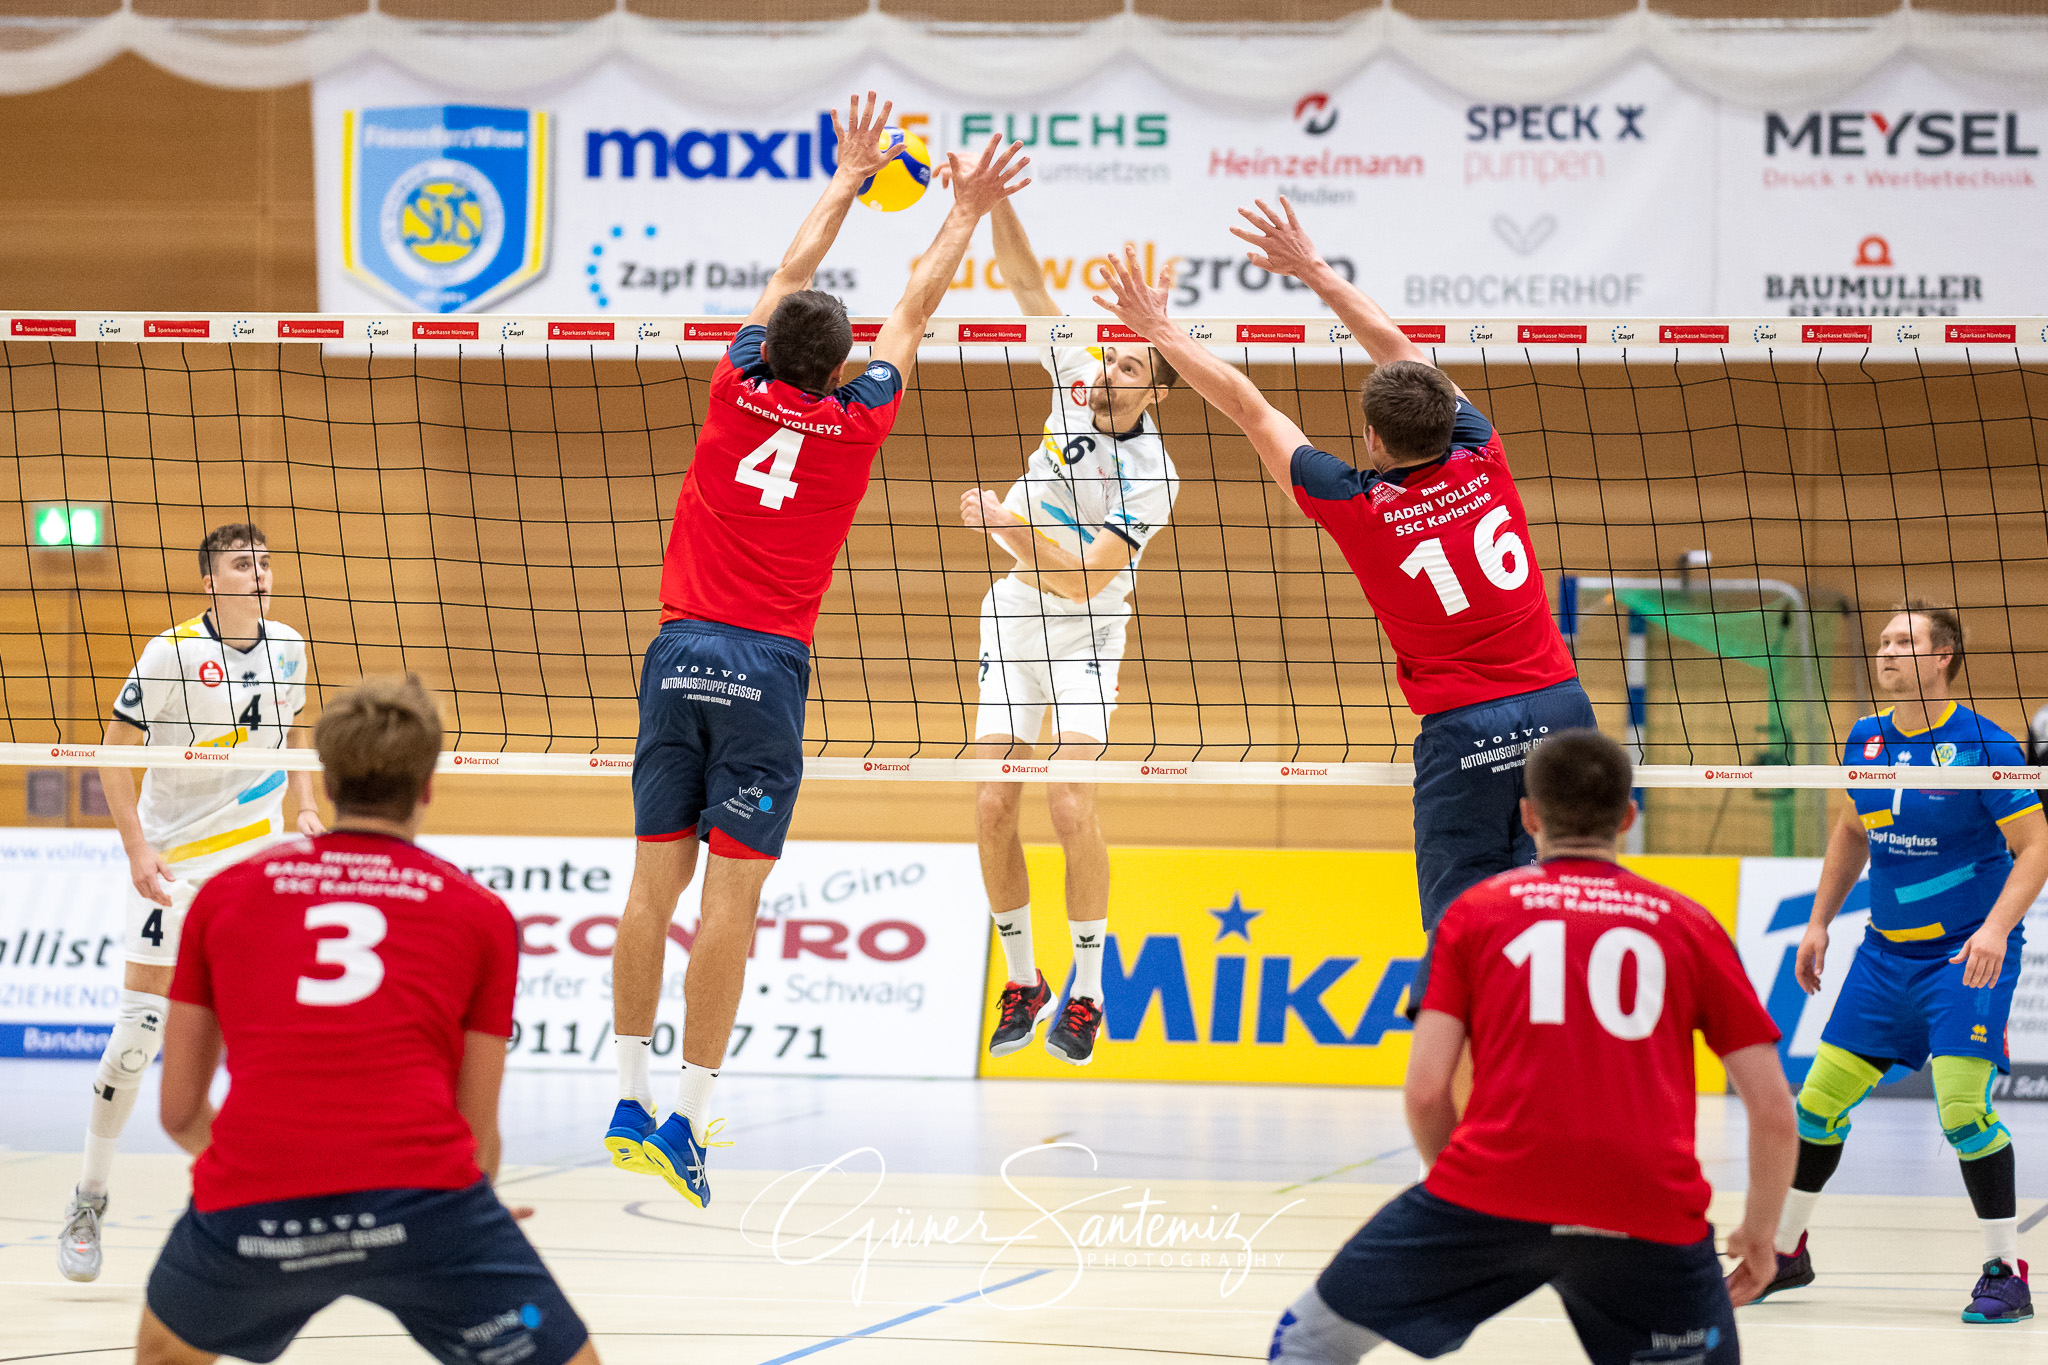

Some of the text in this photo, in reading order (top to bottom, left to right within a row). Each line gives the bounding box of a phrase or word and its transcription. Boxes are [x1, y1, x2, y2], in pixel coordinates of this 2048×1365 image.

[1467, 104, 1600, 142] SPECK
[960, 113, 1169, 147] FUCHS
[1765, 112, 2039, 157] MEYSEL
[1208, 147, 1424, 178] Heinzelmann
[1465, 149, 1606, 186] pumpen
[1763, 166, 1834, 189] Druck
[1865, 166, 2036, 189] Werbetechnik
[619, 261, 695, 294] Zapf
[25, 326, 72, 334] Sparkasse Nürnberg
[157, 326, 205, 336] Sparkasse Nürnberg
[289, 327, 340, 336] Sparkasse Nürnberg
[425, 329, 475, 338] Sparkasse Nürnberg
[508, 329, 524, 337] Zapf
[561, 330, 610, 339] Sparkasse Nürnberg
[644, 330, 661, 338] Zapf
[697, 330, 738, 338] Sparkasse Nürn
[972, 331, 1022, 340] Sparkasse Nürnberg
[1111, 331, 1137, 340] Sparkasse
[1250, 331, 1301, 341] Sparkasse Nürnberg
[1335, 332, 1352, 340] Zapf
[1416, 332, 1442, 341] Nürnberg
[1532, 332, 1583, 341] Sparkasse Nürnberg
[1617, 333, 1635, 341] Zapf
[1673, 332, 1724, 341] Sparkasse Nürnberg
[1760, 332, 1777, 340] Zapf
[1816, 332, 1867, 342] Sparkasse Nürnberg
[1903, 332, 1920, 340] Zapf
[1959, 332, 2011, 342] Sparkasse Nürnberg
[736, 396, 780, 423] BADEN
[782, 418, 843, 436] VOLLEYS
[1062, 436, 1096, 465] 6
[734, 427, 806, 511] 4
[1420, 480, 1449, 497] BENZ
[1383, 501, 1434, 524] BADEN
[1435, 472, 1490, 508] VOLLEYS
[1395, 520, 1425, 537] SSC
[1426, 492, 1492, 528] Karlsruhe
[1398, 504, 1530, 617] 16
[676, 665, 748, 681] VOLVO
[661, 676, 762, 702] AUTOHAUSGRUPPE GEISSER
[239, 693, 262, 731] 4
[1474, 726, 1549, 748] VOLVO
[60, 749, 96, 758] Marmot
[193, 752, 229, 761] Marmot
[463, 756, 500, 765] Marmot
[873, 762, 910, 772] Marmot
[1011, 765, 1049, 774] Marmot
[1151, 766, 1188, 775] Marmot
[1290, 767, 1328, 776] Marmot
[1715, 771, 1753, 779] Marmot
[1858, 771, 1897, 780] Marmot
[2002, 771, 2041, 780] Marmot
[1889, 833, 1938, 848] Daigfuss
[264, 861, 343, 878] BADEN
[821, 862, 926, 904] Gino
[1509, 882, 1580, 898] BADEN
[141, 908, 164, 947] 4
[296, 900, 388, 1008] 3
[1502, 920, 1667, 1041] 10
[787, 973, 926, 1013] Schwaig
[775, 1025, 827, 1059] 71
[259, 1212, 377, 1235] VOLVO
